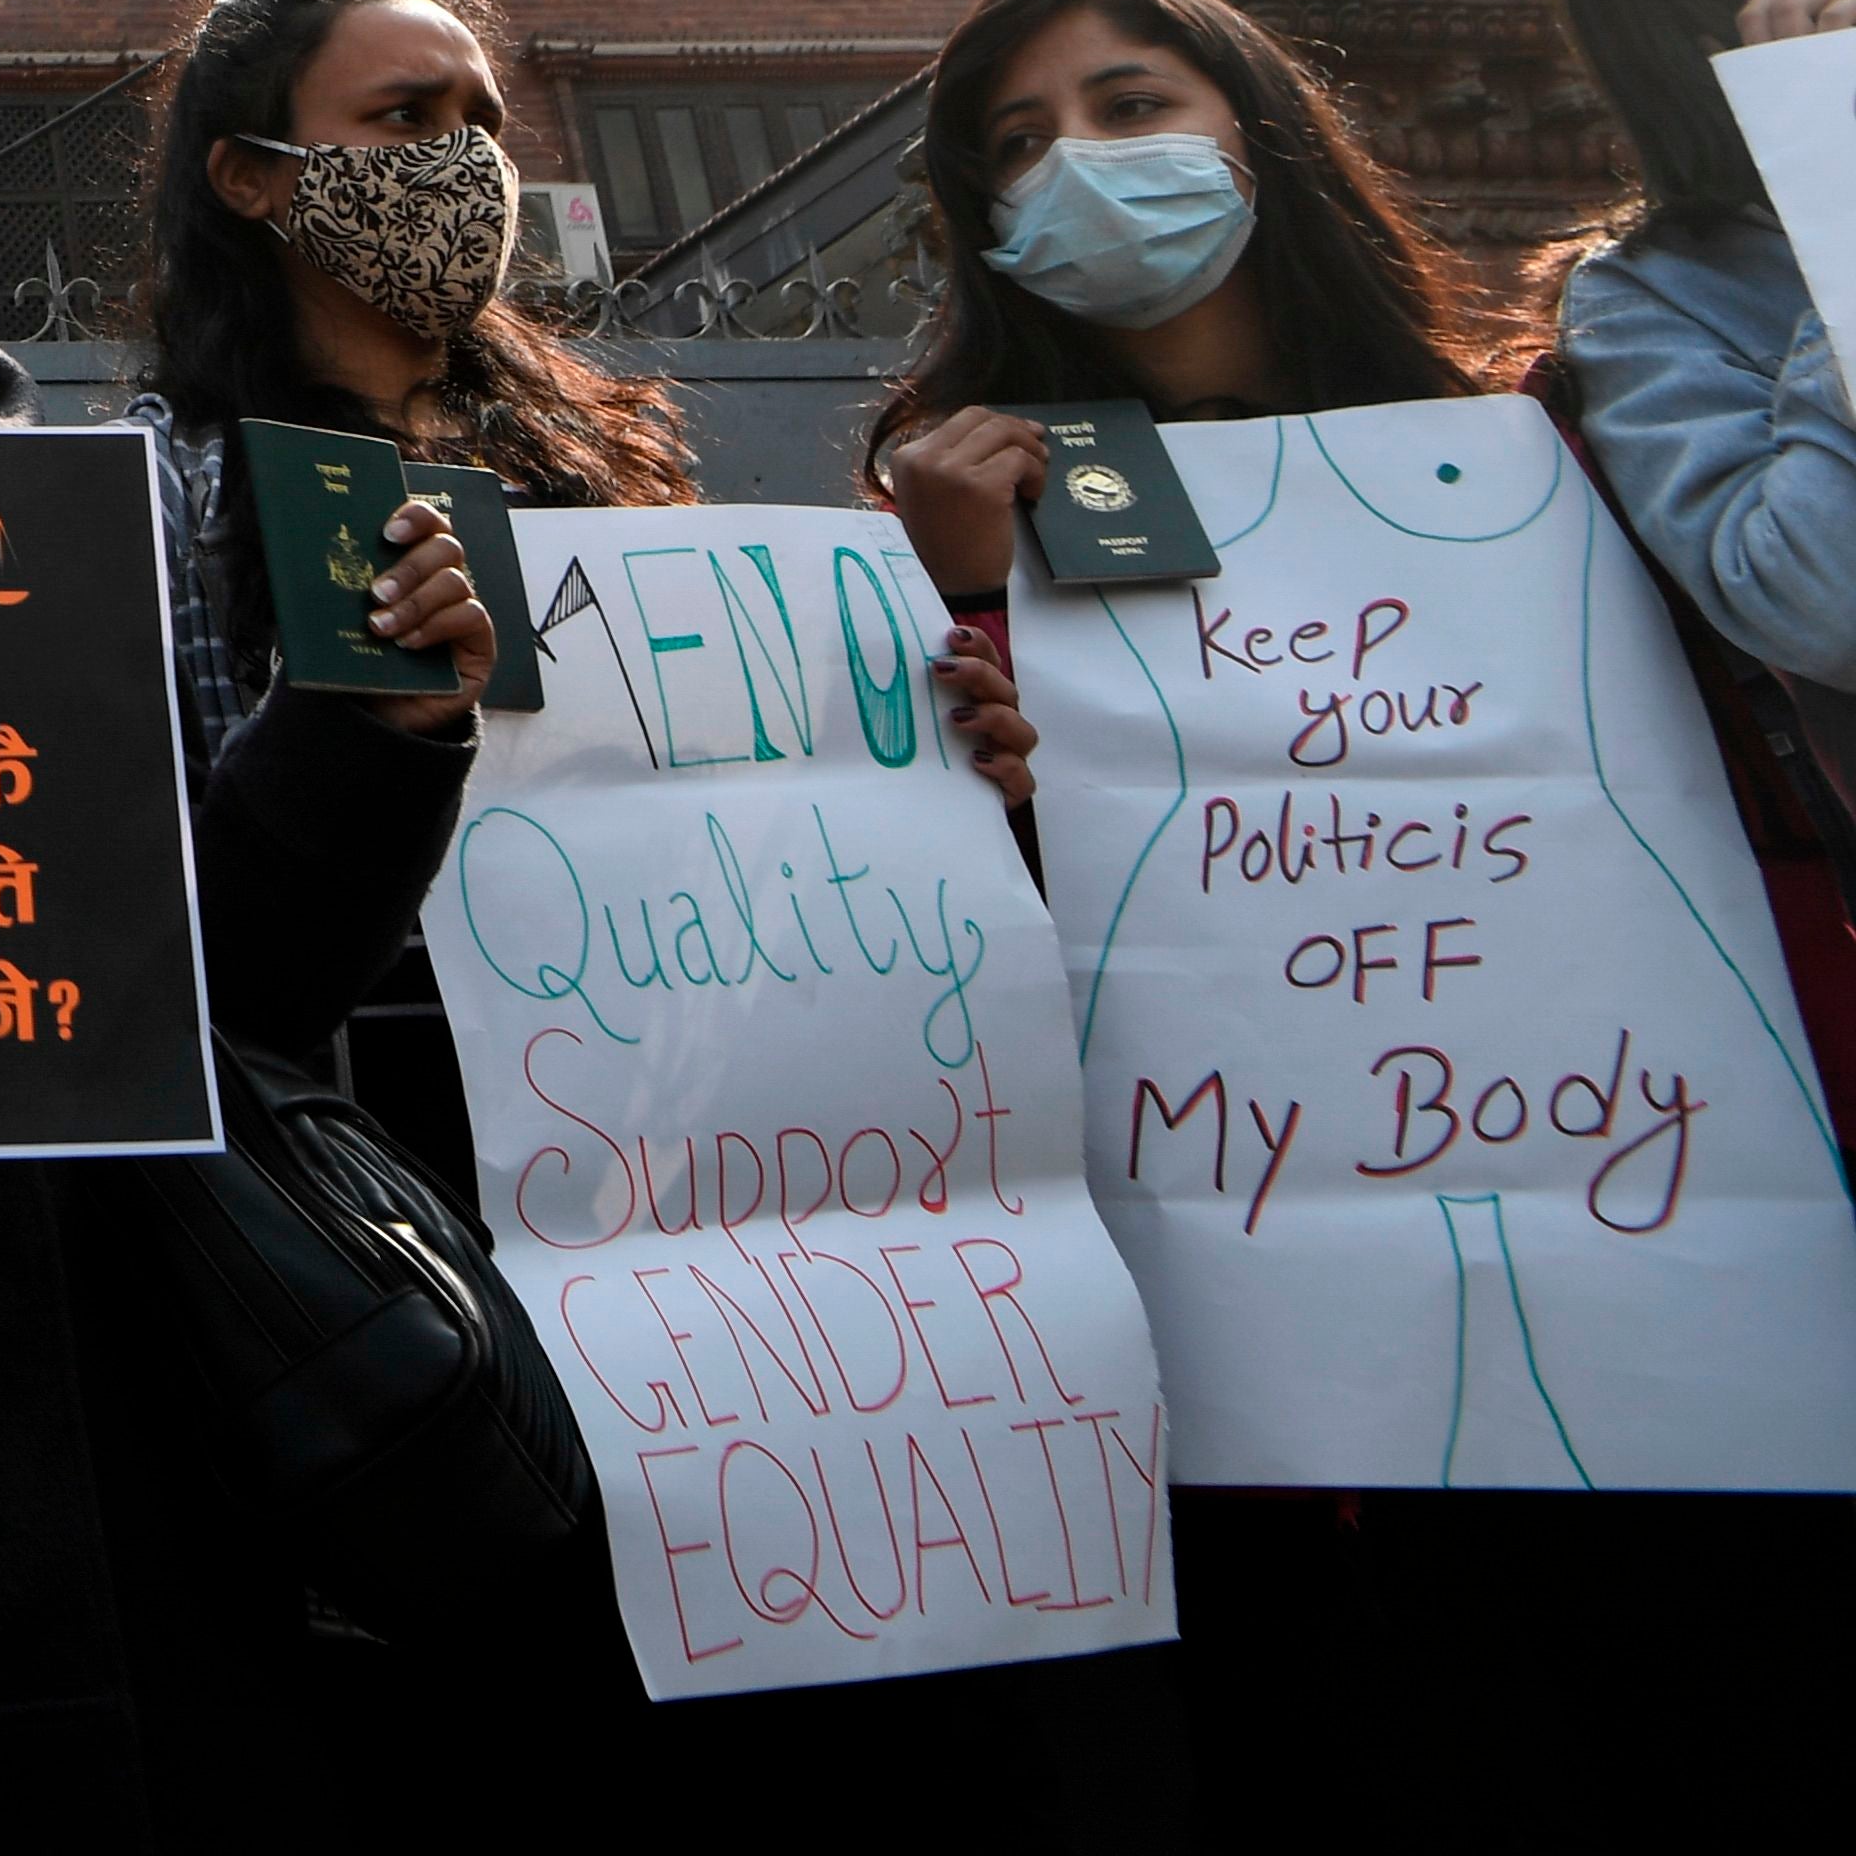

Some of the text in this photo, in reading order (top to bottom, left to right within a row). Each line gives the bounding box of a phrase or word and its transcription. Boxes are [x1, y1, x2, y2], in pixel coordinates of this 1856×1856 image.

[1288, 680, 1484, 768] your
[459, 803, 984, 1068] Quality
[1284, 917, 1482, 1004] OFF
[517, 1028, 1023, 1262] Support
[1129, 1026, 1708, 1237] My Body
[561, 1235, 1087, 1435] GENDER
[637, 1404, 1168, 1664] EQUALITY
